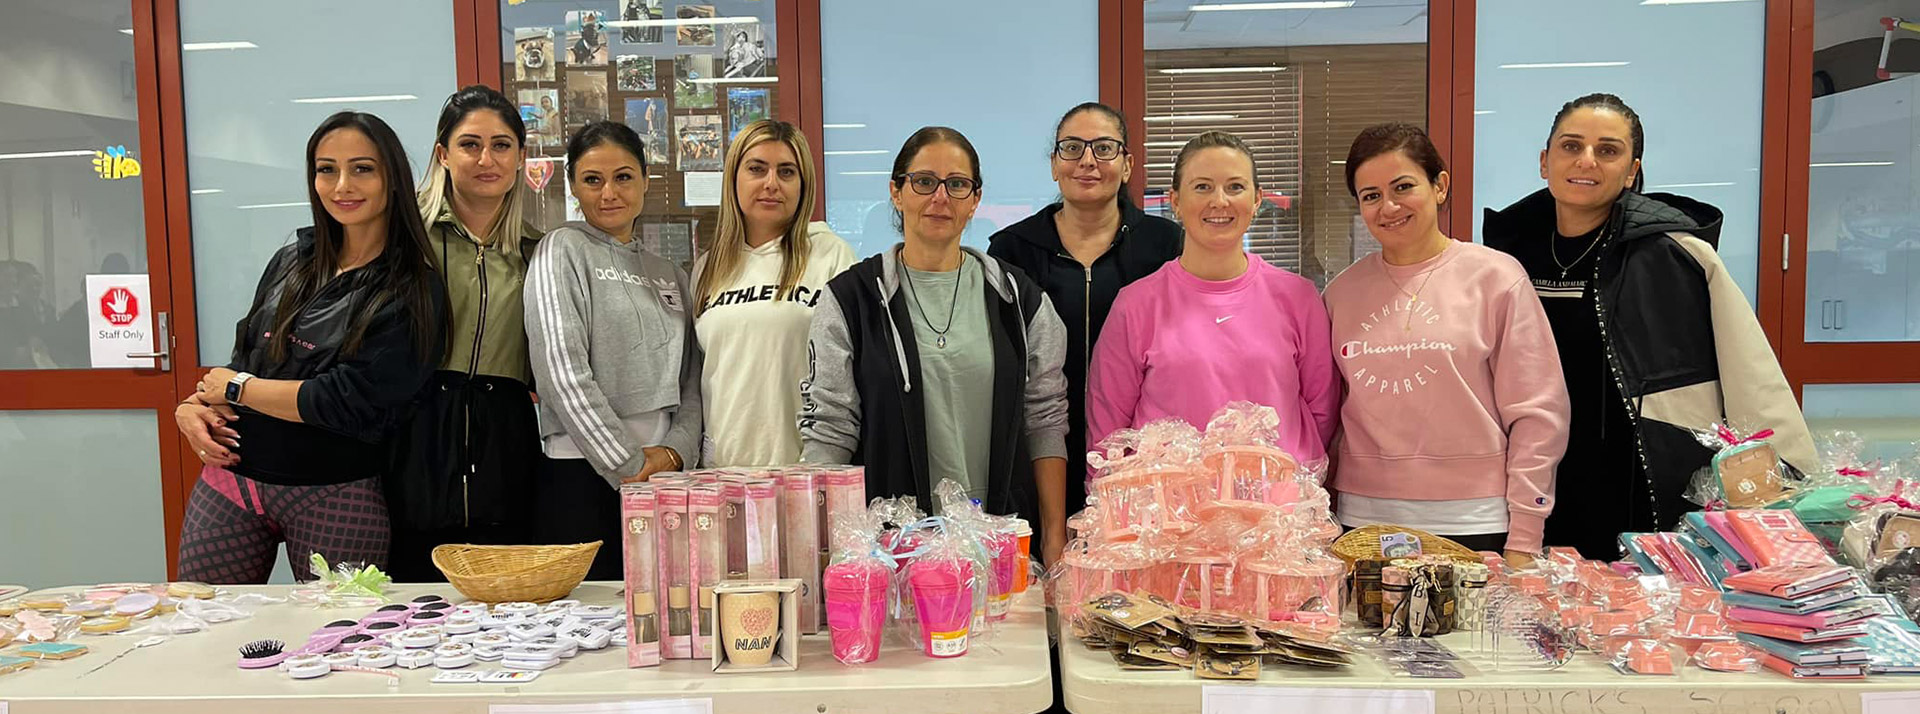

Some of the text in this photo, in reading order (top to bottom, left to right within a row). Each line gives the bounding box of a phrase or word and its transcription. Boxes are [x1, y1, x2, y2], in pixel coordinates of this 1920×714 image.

[595, 266, 651, 287] adidas
[111, 313, 132, 322] STOP
[1361, 299, 1440, 332] ATHLETIC
[99, 330, 144, 341] Staff Only
[1340, 338, 1456, 359] Champion
[1354, 364, 1438, 395] APPAREL
[735, 635, 772, 650] NAN
